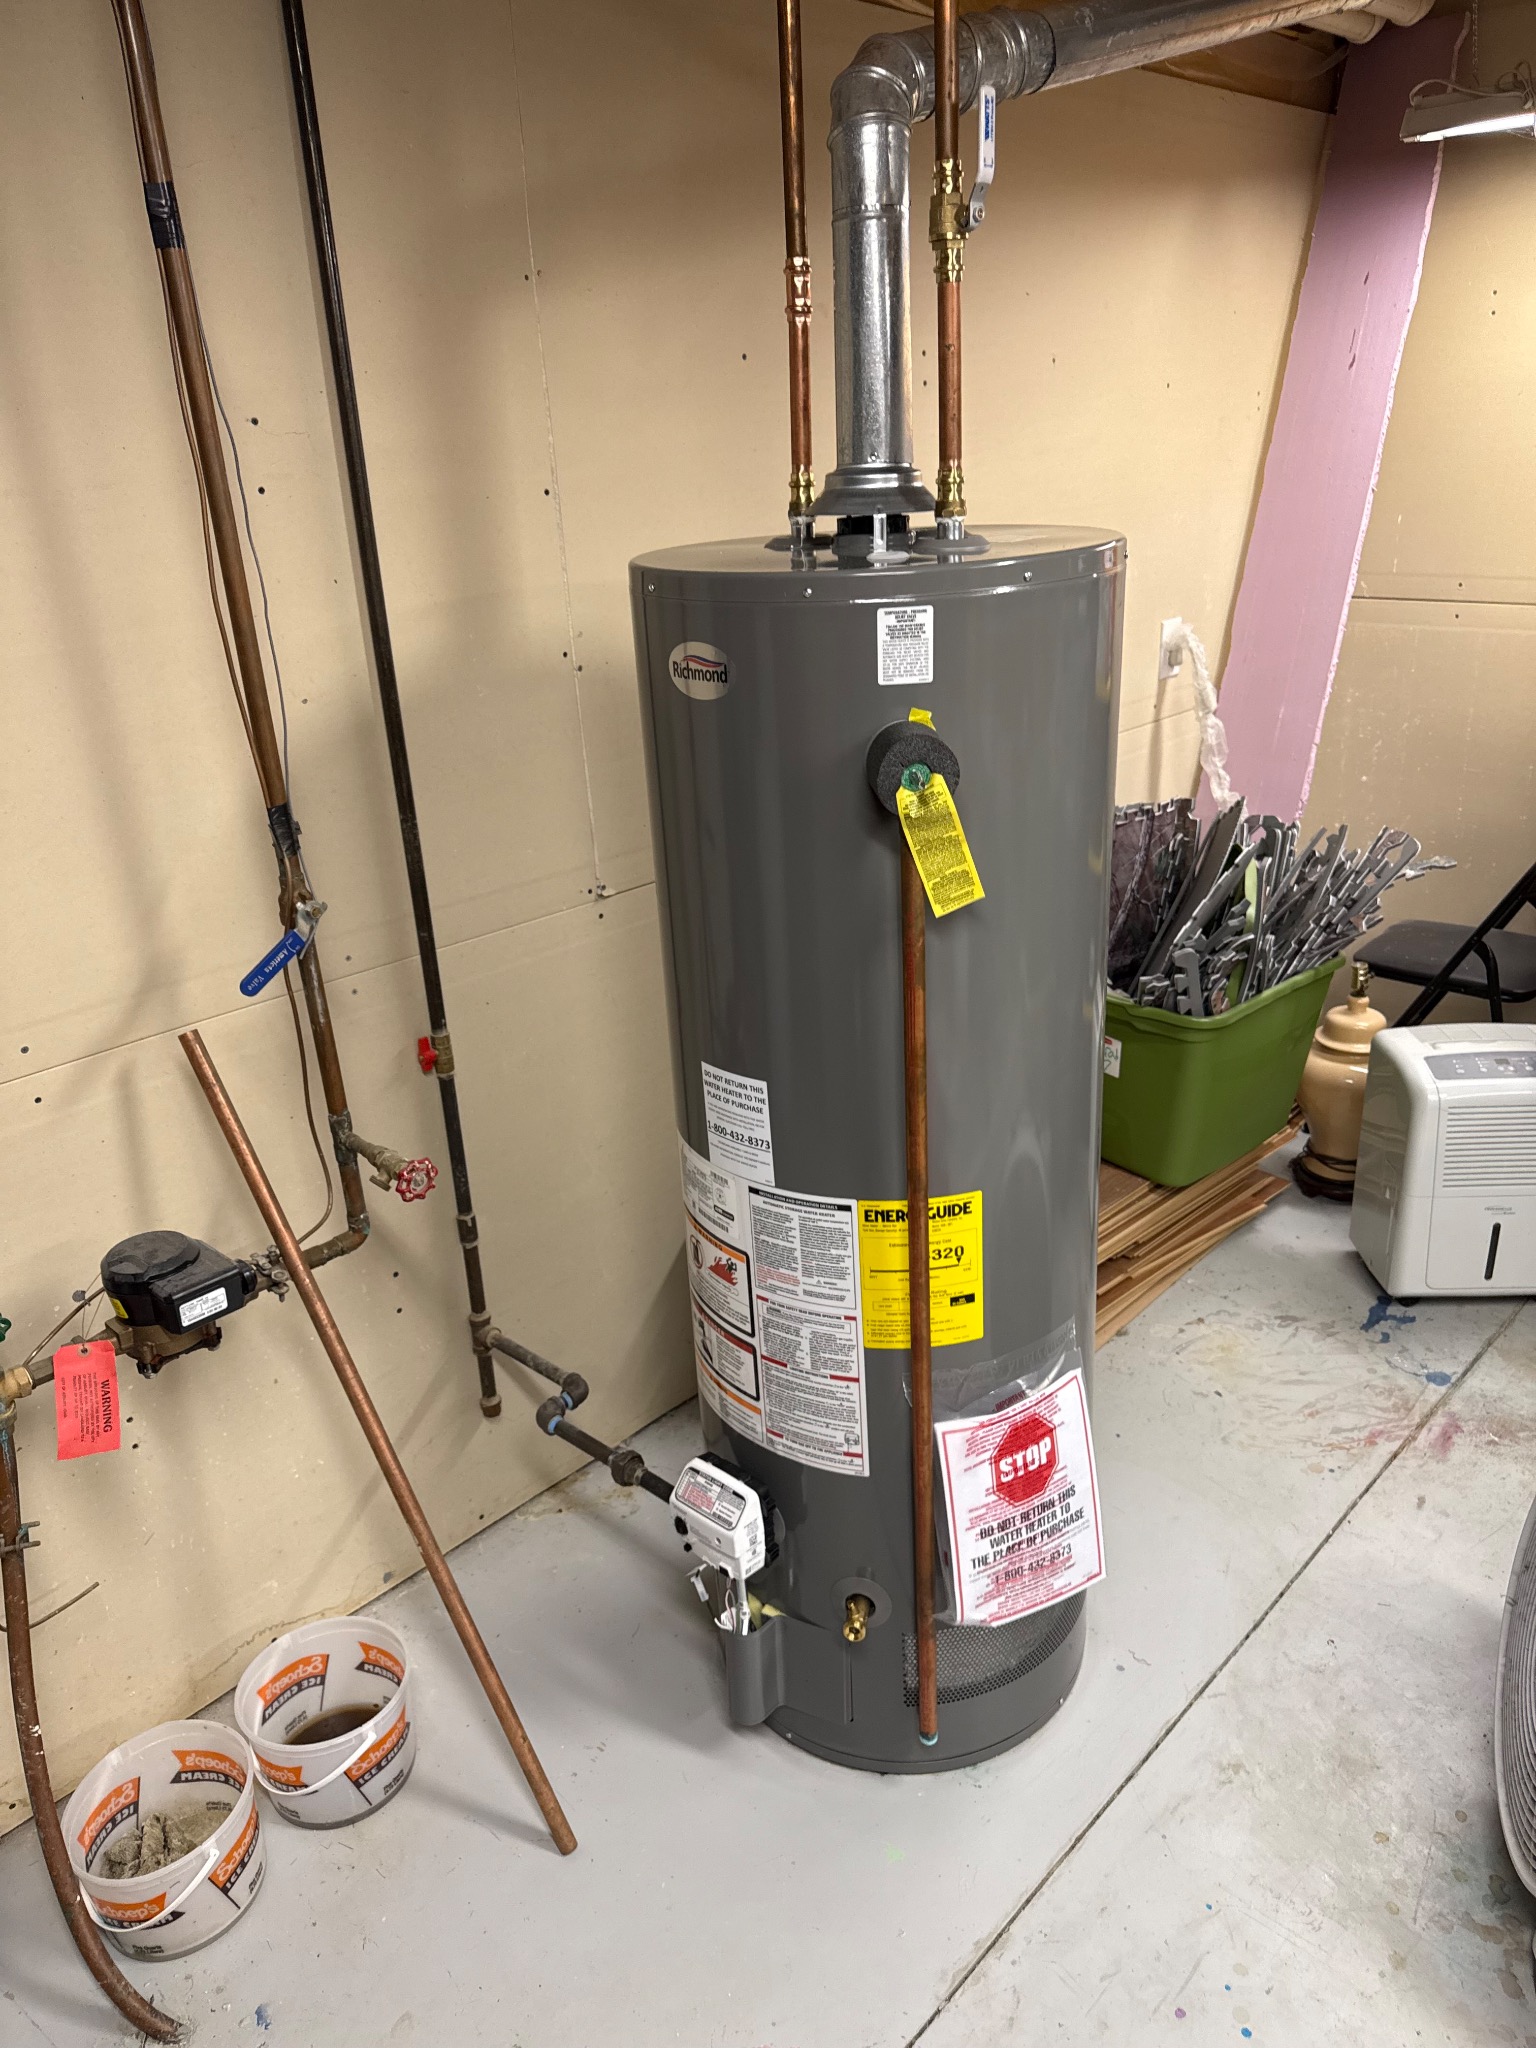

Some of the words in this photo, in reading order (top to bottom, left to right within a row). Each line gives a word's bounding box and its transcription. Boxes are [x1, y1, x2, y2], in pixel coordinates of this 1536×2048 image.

[672, 660, 728, 684] Richmond
[704, 1069, 712, 1078] DO
[712, 1073, 723, 1083] NOT
[724, 1078, 748, 1091] RETURN
[749, 1085, 764, 1094] THIS
[704, 1080, 720, 1092] WATER
[721, 1087, 743, 1099] HEATER
[744, 1094, 752, 1102] TO
[754, 1096, 766, 1105] THE
[707, 1090, 721, 1102] PLACE
[731, 1100, 763, 1114] PURCHASE
[707, 1120, 771, 1150] 1-800-432-8373
[100, 1379, 113, 1433] WARNING
[999, 1436, 1052, 1483] STOP
[979, 1524, 994, 1540] DO
[997, 1516, 1017, 1533] NOT
[1020, 1497, 1056, 1524] RETURN
[1058, 1484, 1076, 1503] THIS
[989, 1526, 1024, 1549] WATER
[1025, 1510, 1057, 1535] HEATER
[1060, 1501, 1071, 1517] TO
[970, 1553, 991, 1570] THE
[992, 1538, 1025, 1563] PLACE
[1040, 1506, 1084, 1543] PURCHASE
[995, 1542, 1072, 1584] 1-800-432-8373
[358, 1765, 379, 1784] ICE
[226, 1864, 243, 1888] ICE
